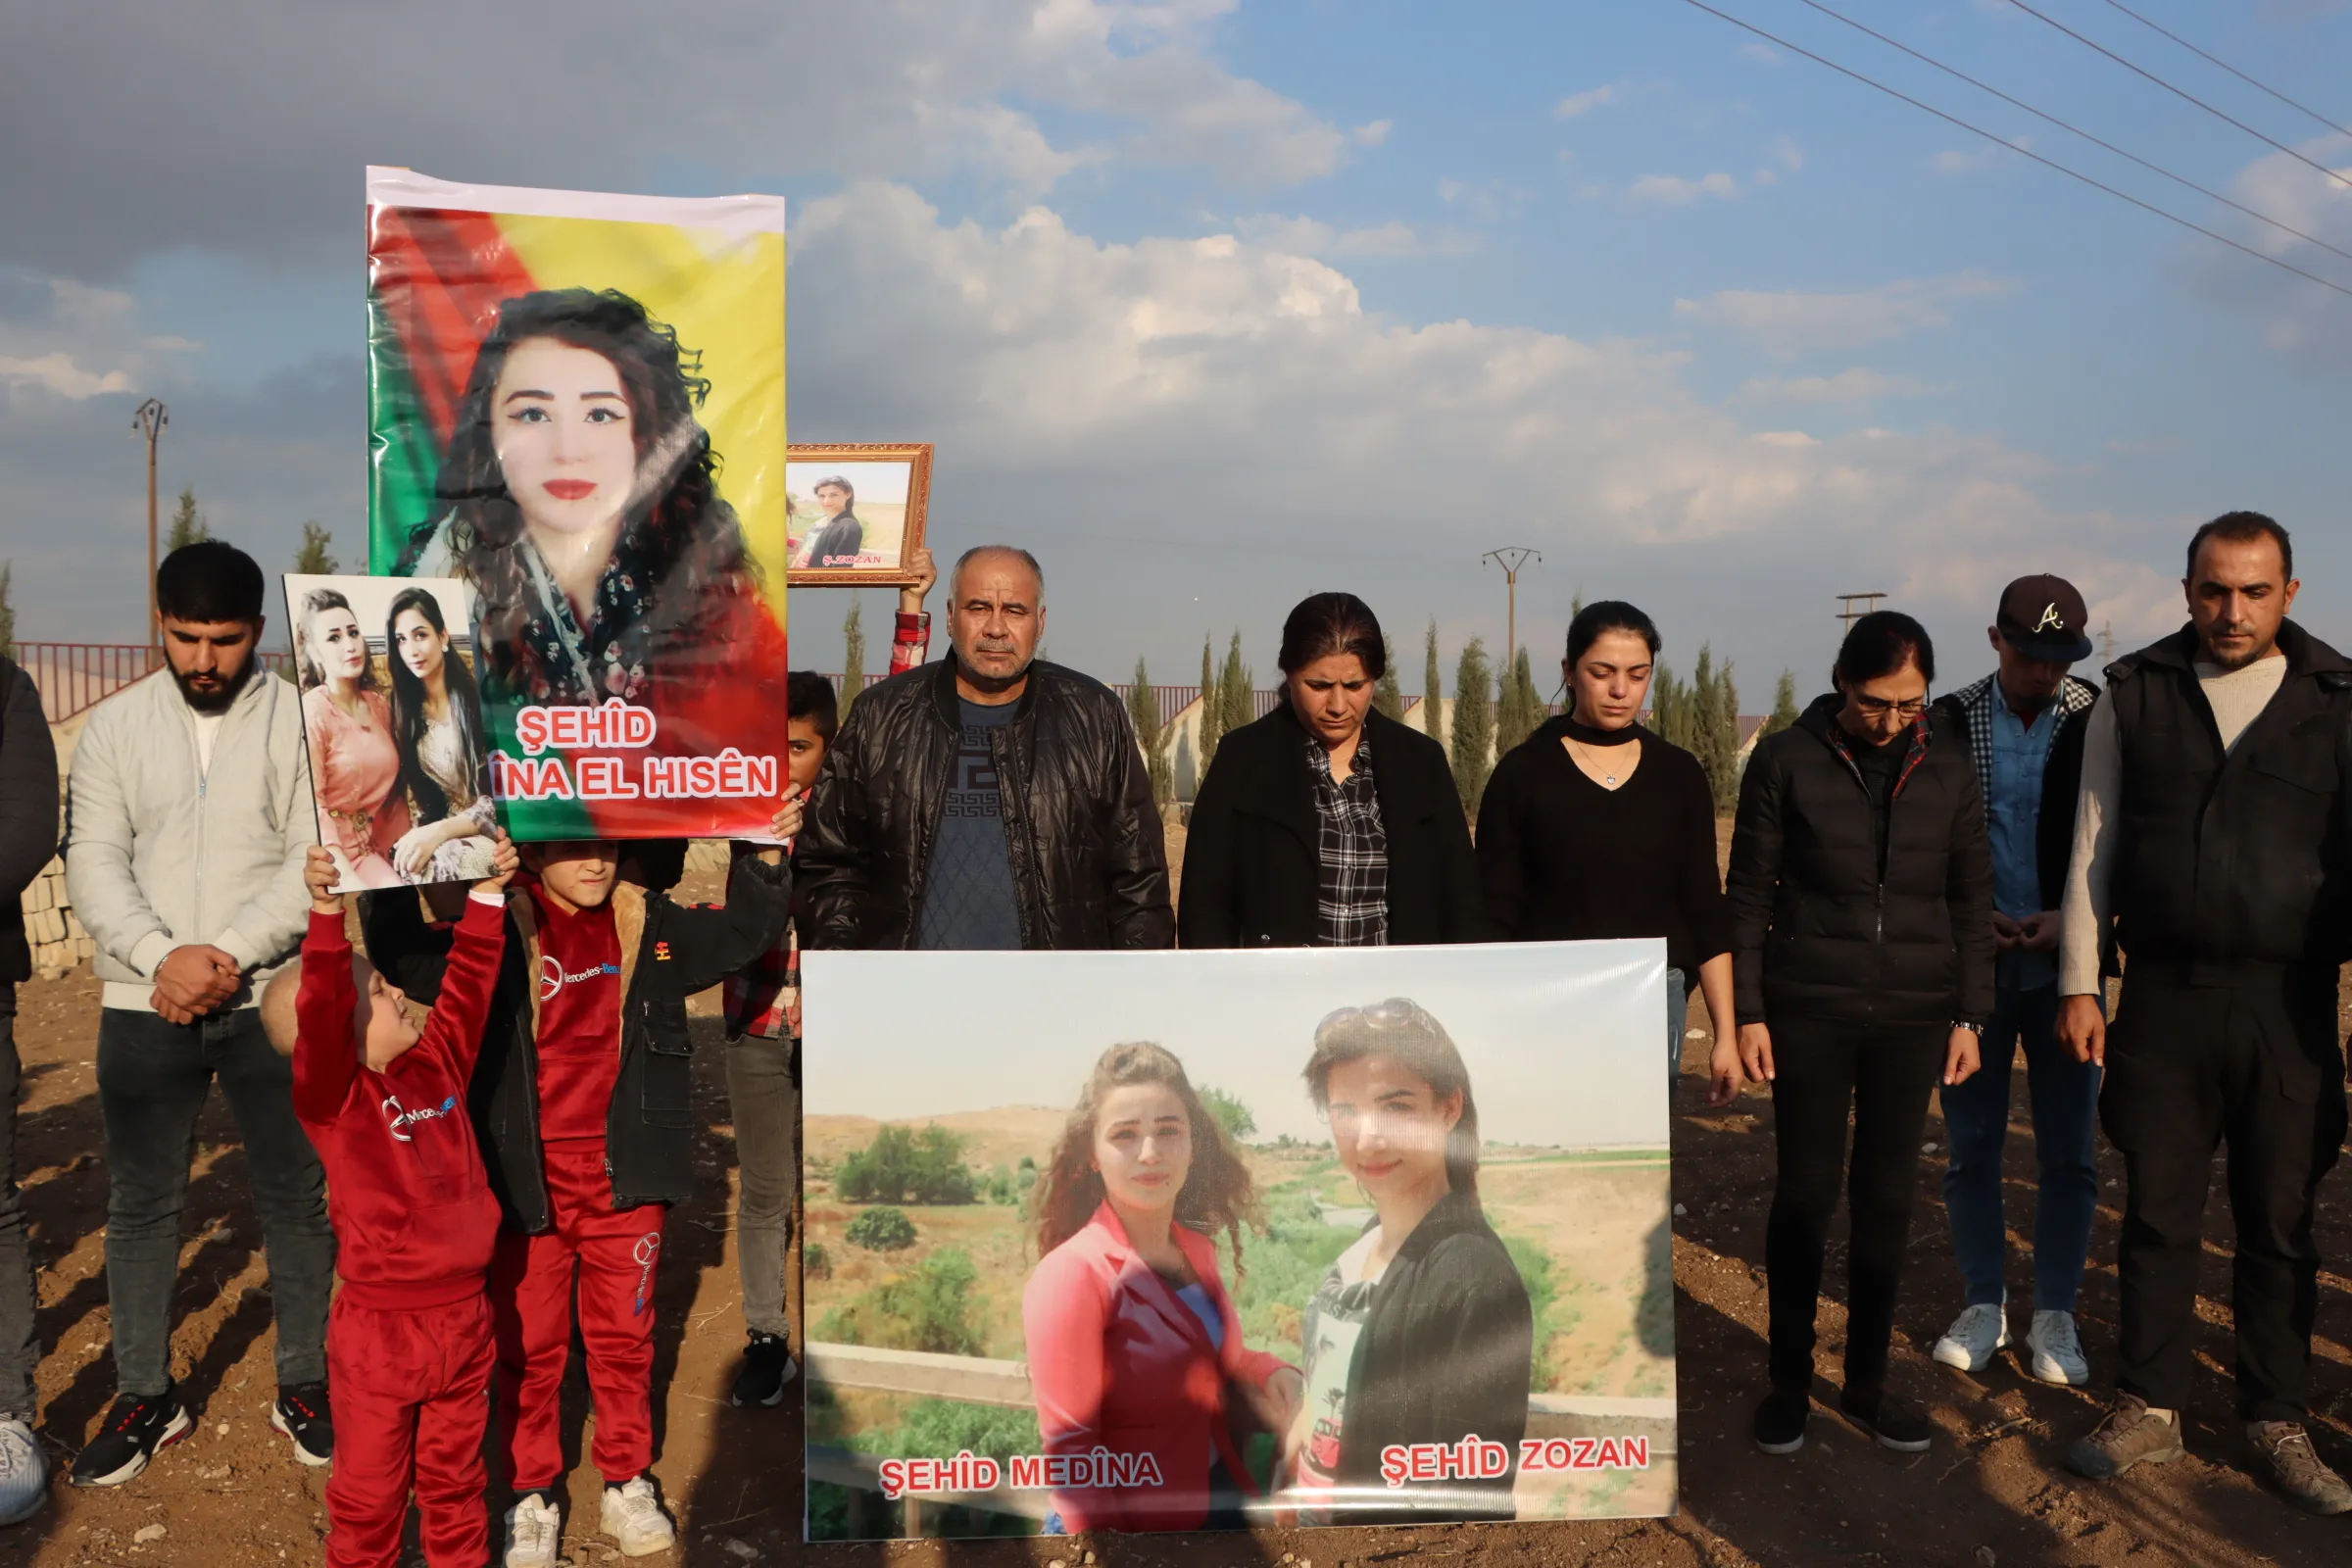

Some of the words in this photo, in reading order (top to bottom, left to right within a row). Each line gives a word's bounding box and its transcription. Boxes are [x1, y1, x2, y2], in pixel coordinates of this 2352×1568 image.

[518, 699, 655, 753] ŞEHÎD
[489, 752, 572, 798] ÎNA
[578, 760, 637, 797] EL
[646, 750, 777, 796] HISÊN
[881, 1450, 999, 1497] ŞEHÎD
[1010, 1447, 1161, 1488] MEDÎNA
[1382, 1435, 1507, 1487] ŞEHÎD
[1520, 1437, 1648, 1470] ZOZAN
